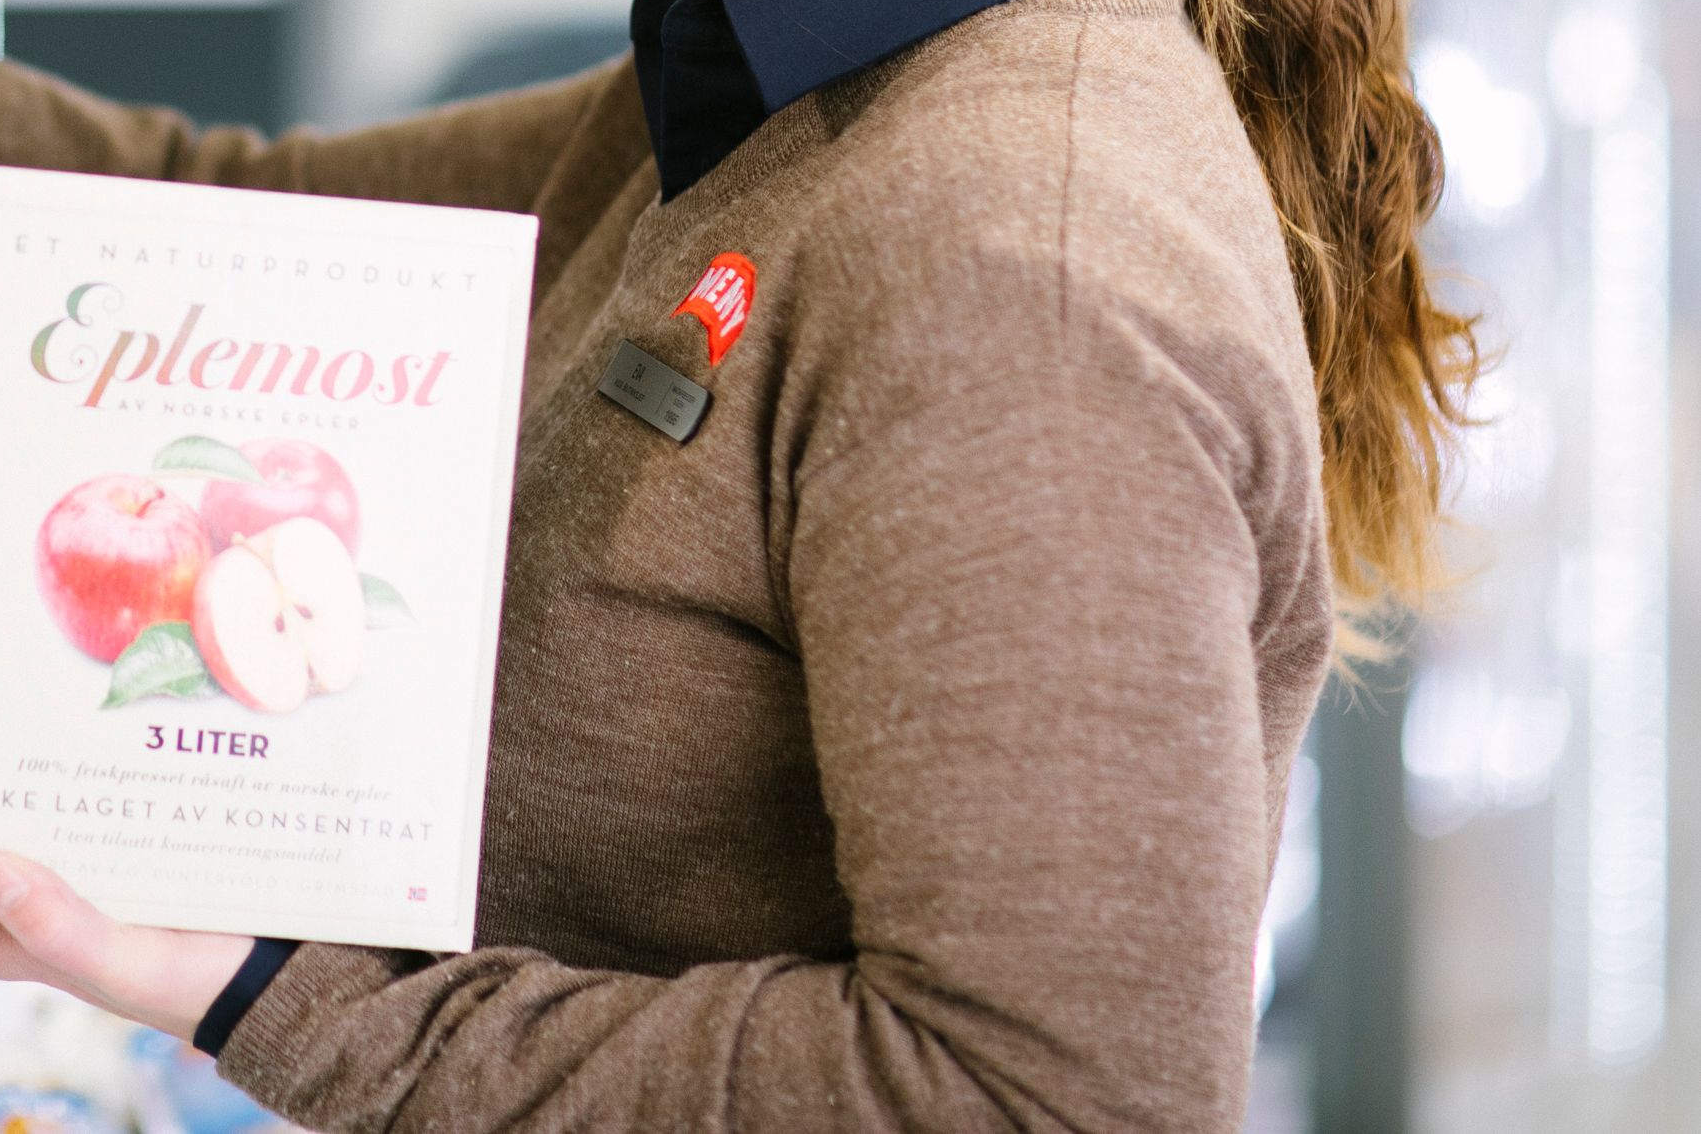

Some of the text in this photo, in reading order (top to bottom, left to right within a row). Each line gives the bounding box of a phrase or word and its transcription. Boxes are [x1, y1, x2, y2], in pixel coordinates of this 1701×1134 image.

[15, 234, 477, 293] ET NATURPRODUKT
[29, 281, 459, 410] Eplemost
[118, 397, 361, 430] AV NORSKE EPLER
[144, 724, 270, 760] 3 LITER
[17, 755, 393, 806] 100% friskpresset råsaft av norske epler
[55, 793, 156, 820] LAGET
[171, 805, 209, 823] AV
[224, 807, 434, 843] KONSENTRAT
